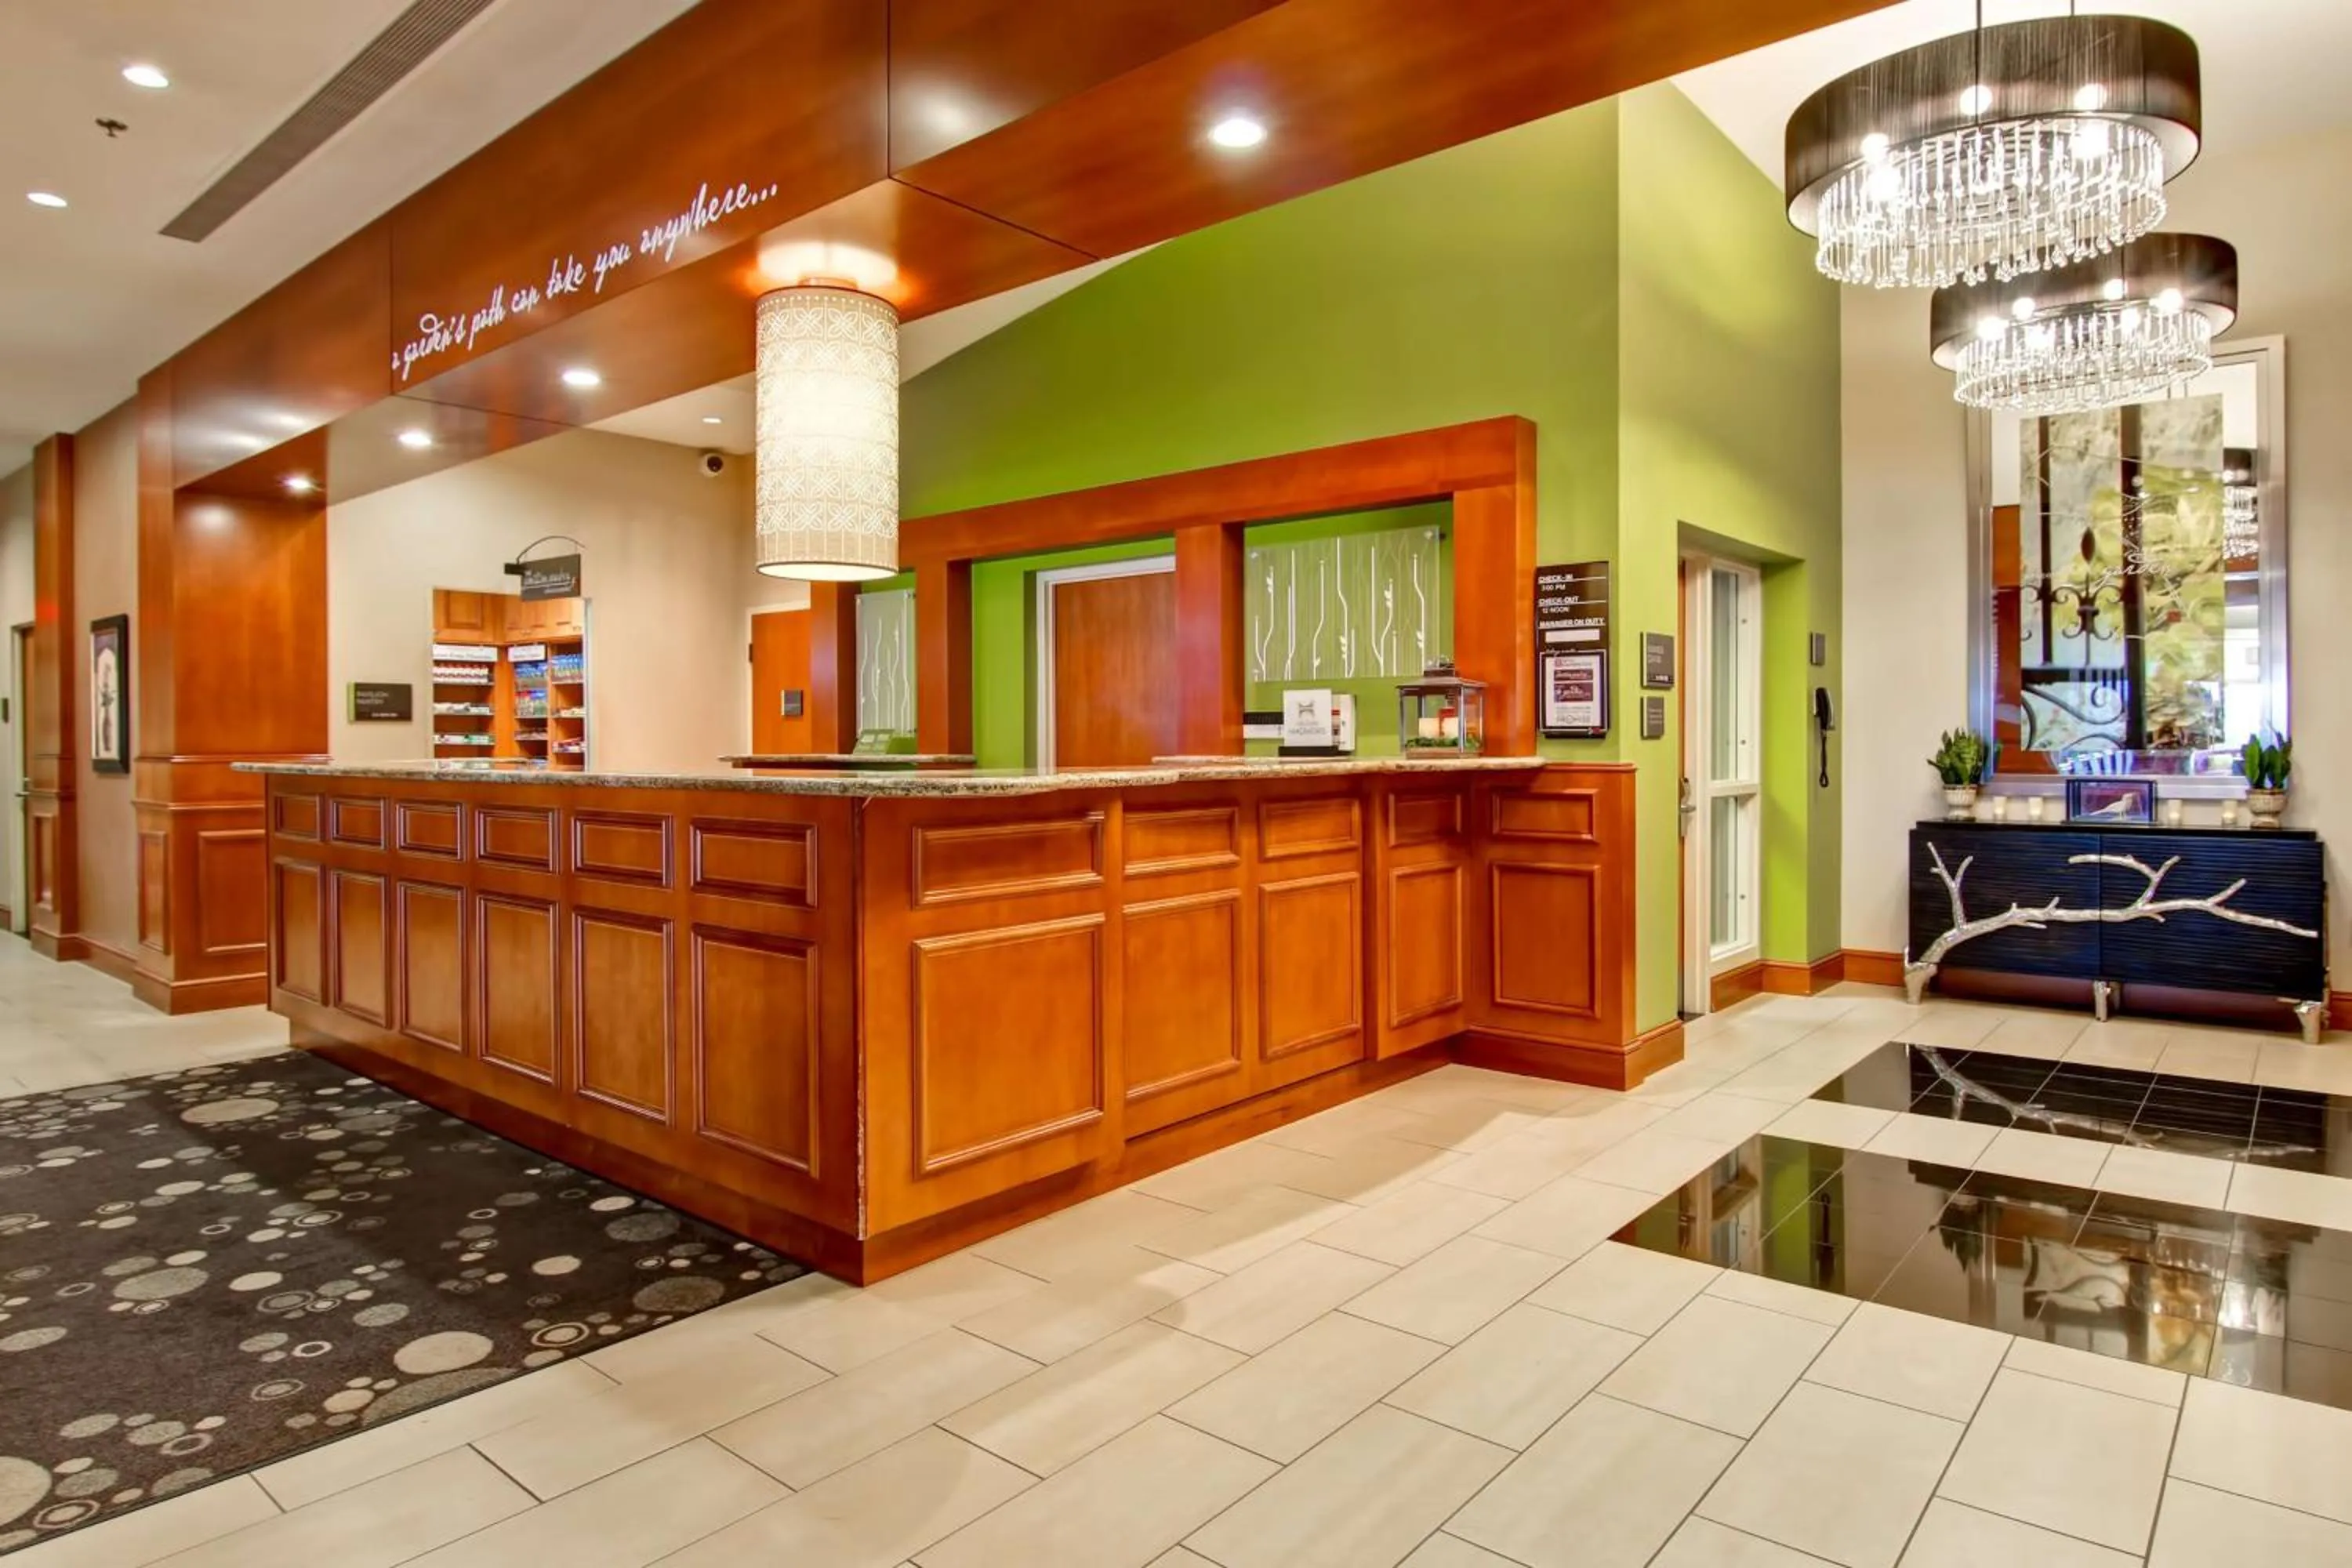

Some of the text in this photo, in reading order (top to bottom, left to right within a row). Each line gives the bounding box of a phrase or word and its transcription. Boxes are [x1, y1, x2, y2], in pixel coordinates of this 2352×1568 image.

[401, 314, 467, 382] garden's
[468, 284, 506, 351] path
[511, 285, 540, 314] can
[546, 254, 586, 299] take
[593, 243, 632, 294] you
[639, 182, 779, 263] anywhere...
[1574, 619, 1584, 627] ON
[1585, 617, 1606, 626] DUTY
